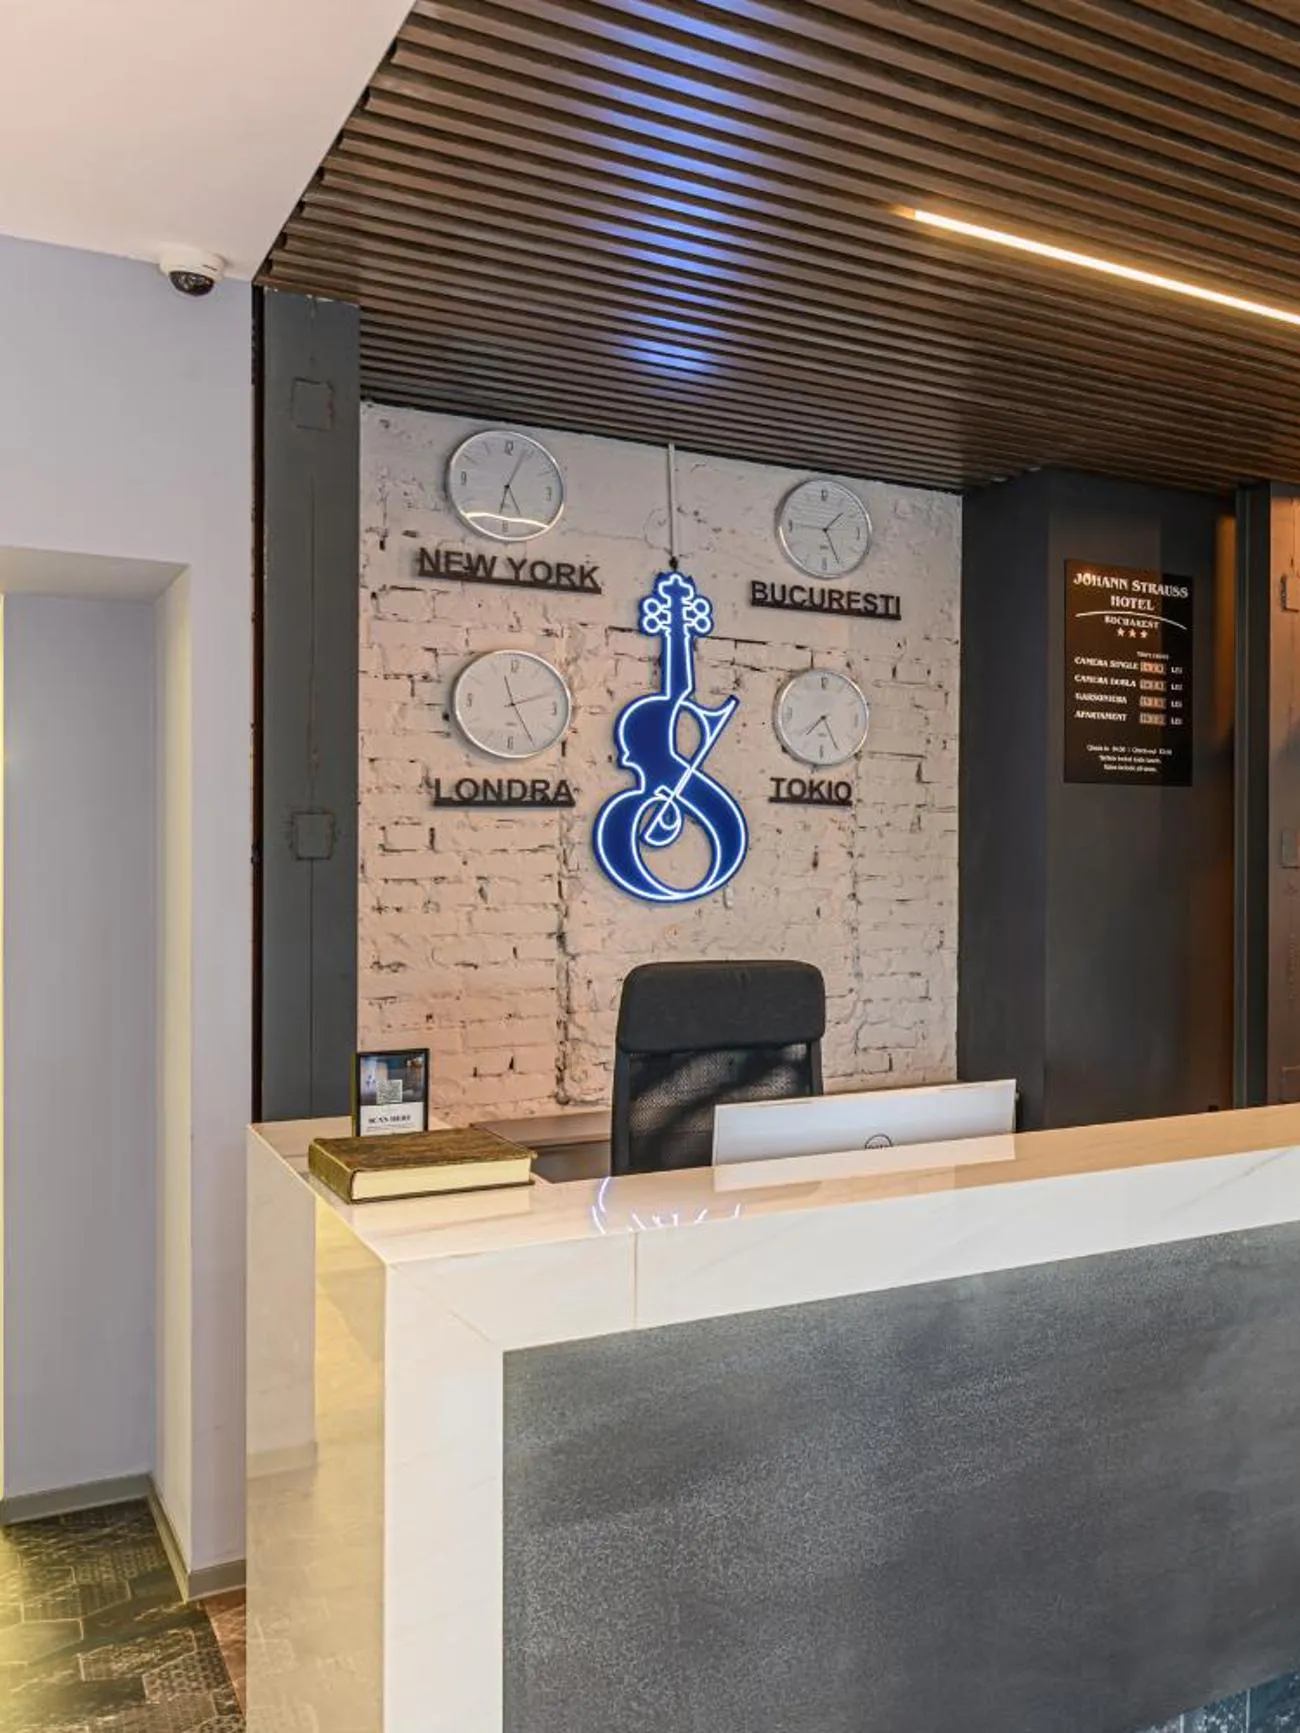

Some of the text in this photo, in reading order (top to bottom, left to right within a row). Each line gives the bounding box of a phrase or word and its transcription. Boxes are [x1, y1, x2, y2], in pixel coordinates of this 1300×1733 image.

[418, 547, 601, 591] NEW YORK
[1073, 573, 1189, 598] JOHANN STRAUSS
[751, 580, 901, 619] BUCURESTI
[1110, 595, 1155, 611] HOTEL
[434, 777, 575, 803] LONDRA
[770, 776, 852, 803] TOKIO
